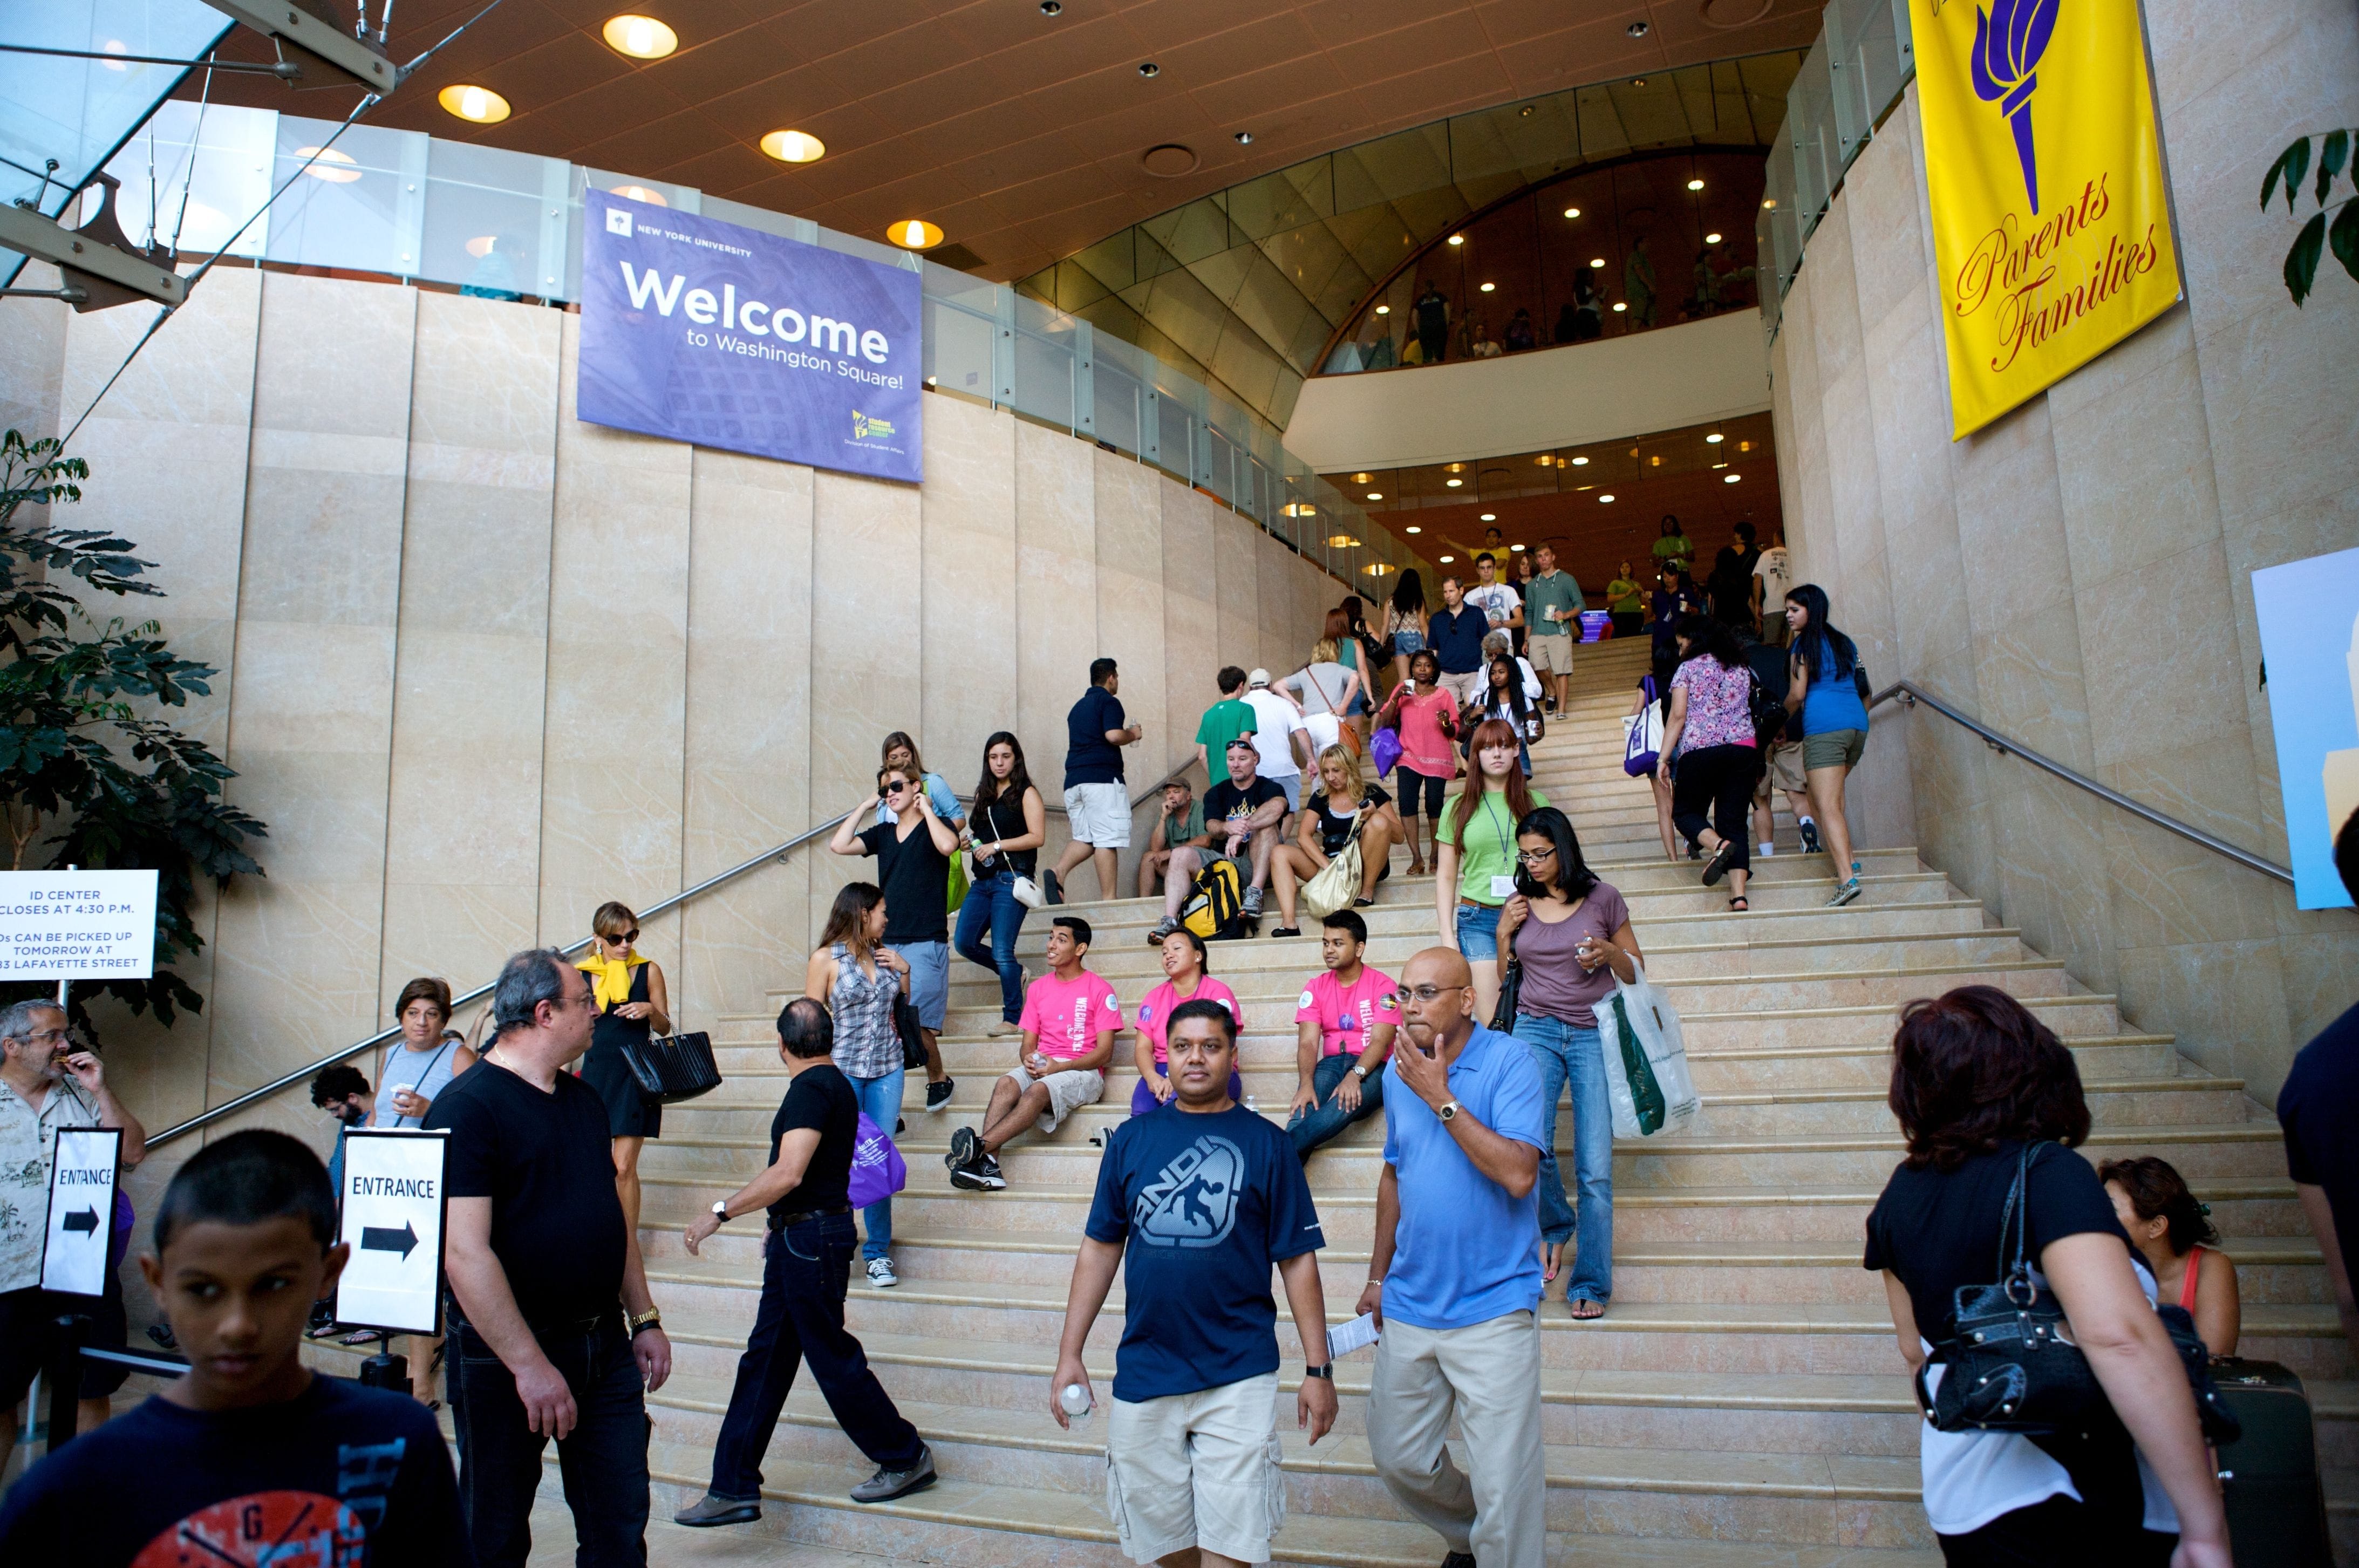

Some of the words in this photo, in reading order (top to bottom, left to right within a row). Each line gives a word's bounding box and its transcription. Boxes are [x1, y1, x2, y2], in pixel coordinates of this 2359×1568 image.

[637, 224, 662, 236] NEW
[664, 230, 691, 244] YORK
[694, 237, 752, 258] UNIVERSITY
[1956, 172, 2110, 317] Parents
[1991, 223, 2157, 372] Families
[619, 261, 889, 364] Welcome
[686, 329, 708, 347] to
[715, 333, 831, 373] Washington
[837, 360, 903, 390] Square!
[844, 439, 863, 447] Division
[890, 447, 905, 455] Affairs
[30, 891, 43, 901] ID
[48, 890, 100, 900] CENTER
[0, 905, 49, 915] CLOSES
[53, 905, 72, 915] AT
[76, 904, 104, 914] 4:30
[109, 904, 135, 913] P.M.
[15, 933, 42, 942] CAN
[46, 933, 62, 942] BE
[66, 932, 112, 942] PICKED
[116, 932, 132, 941] UP
[13, 946, 92, 956] TOMORROW
[96, 945, 113, 955] AT
[15, 959, 88, 969] LAFAYETTE
[92, 958, 139, 967] STREET
[1073, 997, 1088, 1033] WELCOME
[353, 1177, 434, 1199] ENTRANCE
